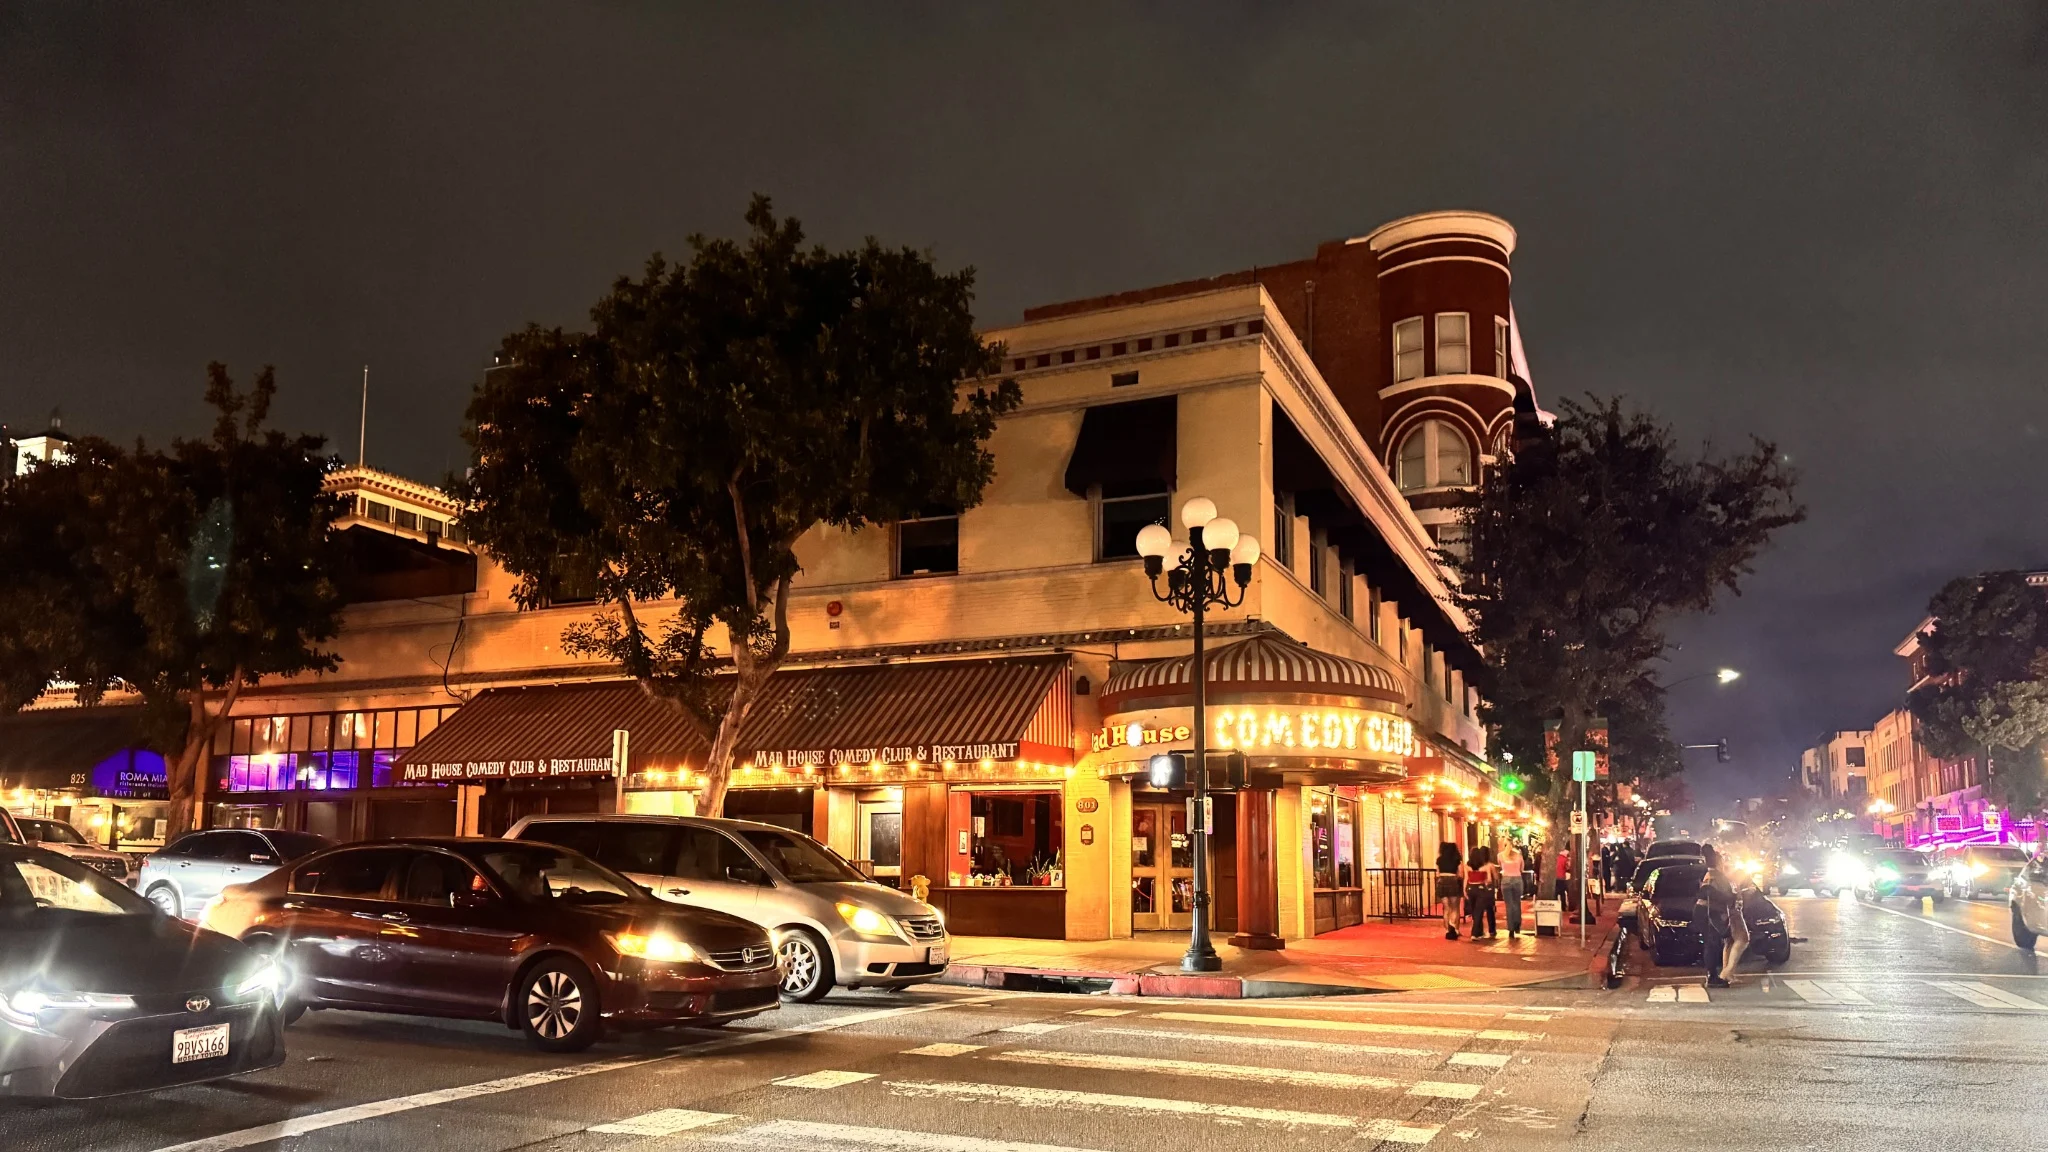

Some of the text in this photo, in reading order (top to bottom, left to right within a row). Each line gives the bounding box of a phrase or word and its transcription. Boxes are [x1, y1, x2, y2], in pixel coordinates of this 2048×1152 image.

[1214, 711, 1362, 749] COMEDY
[754, 742, 1018, 768] MAD HOUSE COMEDY CLUB & RESTAURANT
[70, 773, 86, 784] 825
[120, 771, 149, 782] ROMA
[404, 757, 614, 779] MAD HOUSE COMEDY CLUB & RESTAURAN
[1078, 801, 1096, 809] 801
[177, 1035, 225, 1057] 9BVS166
